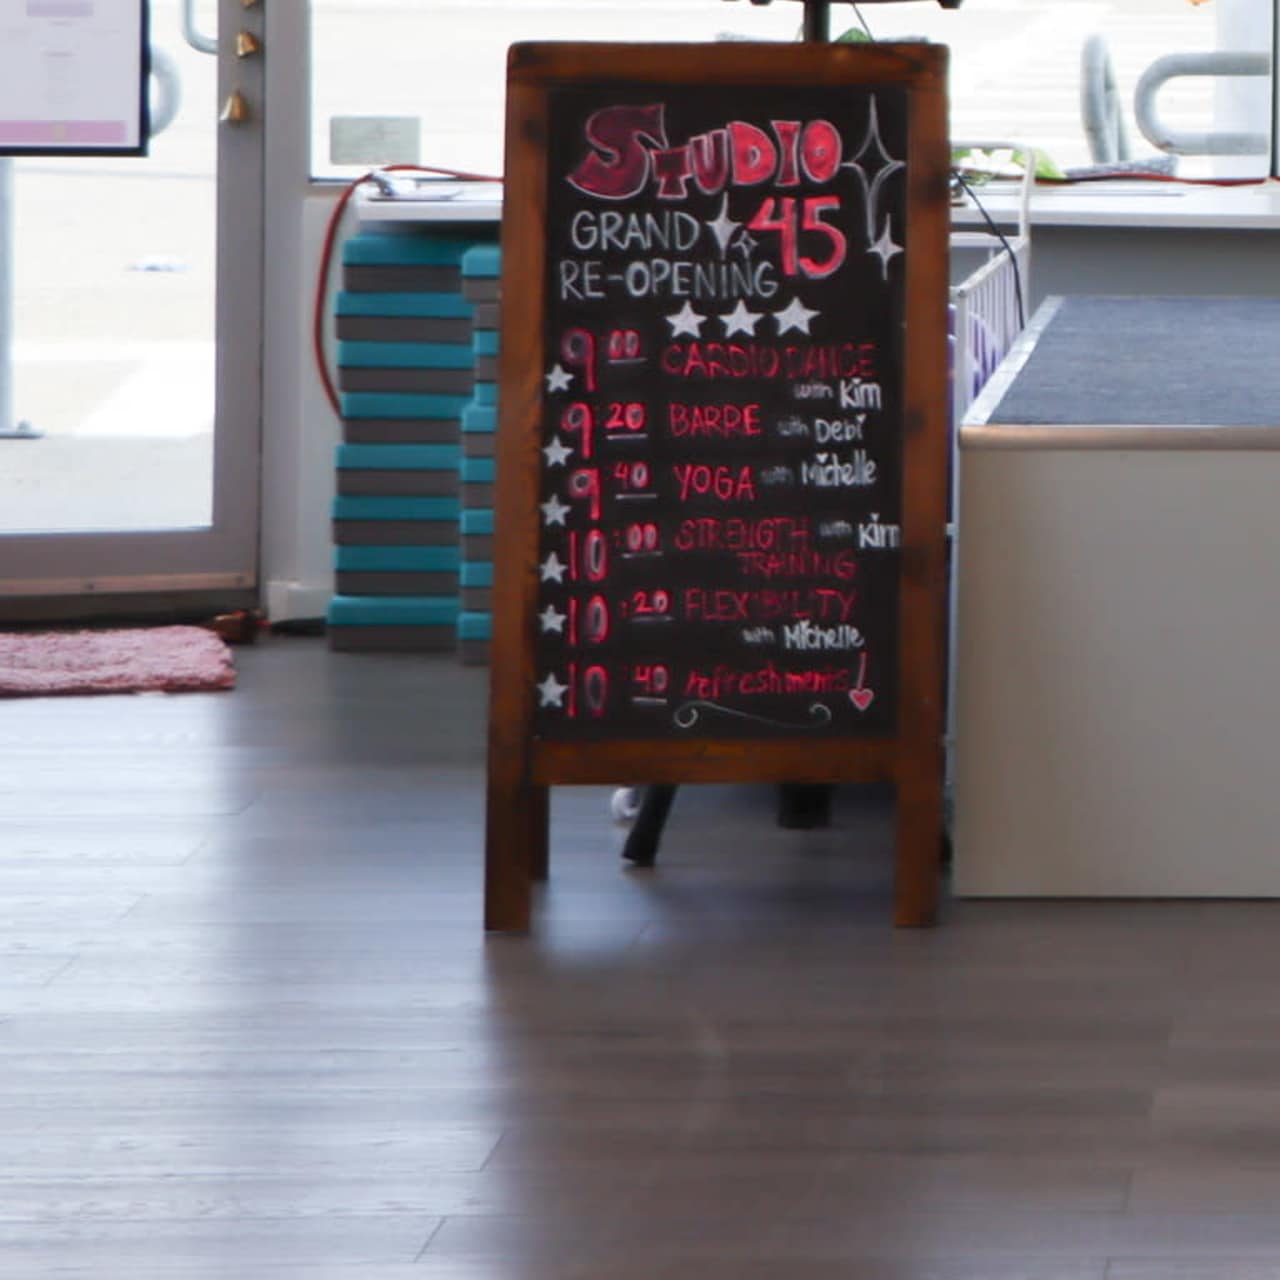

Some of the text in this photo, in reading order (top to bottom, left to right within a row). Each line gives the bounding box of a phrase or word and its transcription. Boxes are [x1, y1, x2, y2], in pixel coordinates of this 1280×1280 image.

[571, 210, 701, 252] GRAND
[747, 193, 847, 280] 45
[560, 259, 779, 300] RE-OPENING
[661, 342, 779, 379] CARDIO
[838, 377, 883, 412] Kim
[814, 412, 867, 443] Debi
[672, 463, 758, 501] YOGA
[800, 449, 877, 488] Michelle
[857, 512, 900, 550] Kim
[783, 618, 866, 652] Michelle
